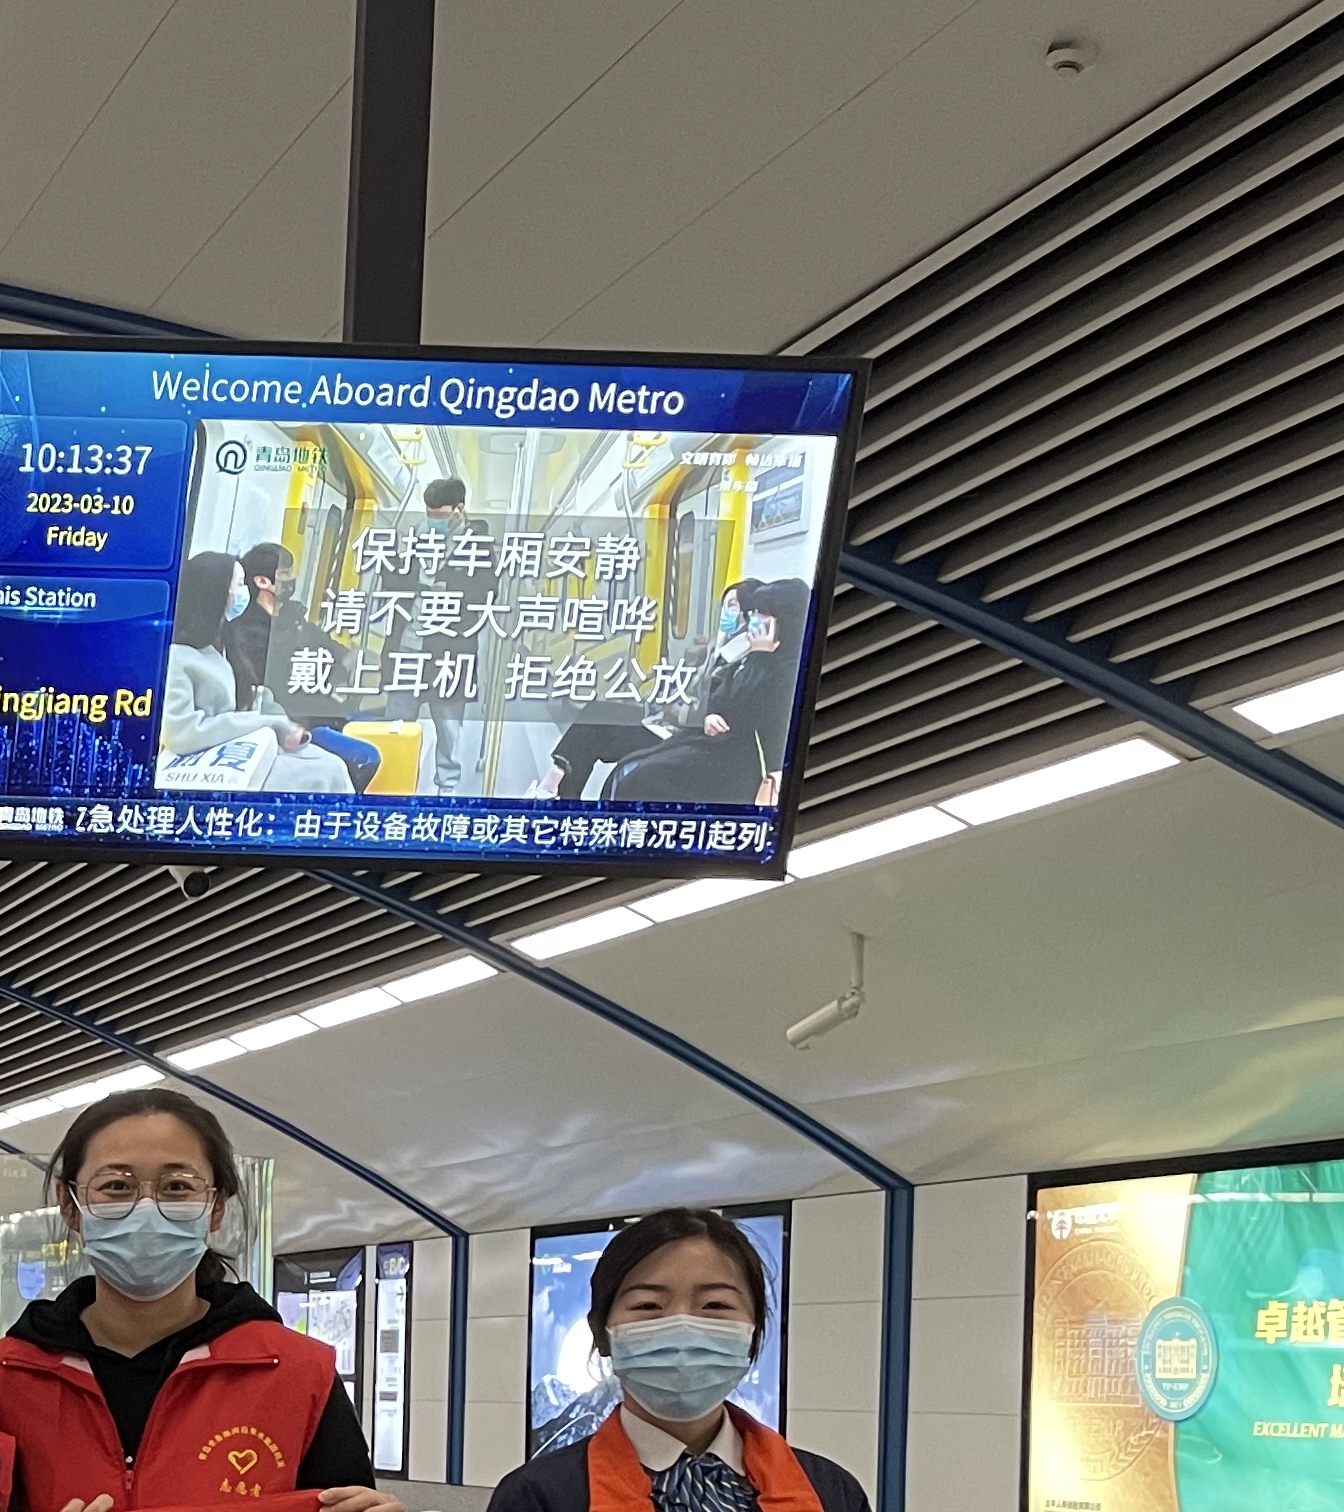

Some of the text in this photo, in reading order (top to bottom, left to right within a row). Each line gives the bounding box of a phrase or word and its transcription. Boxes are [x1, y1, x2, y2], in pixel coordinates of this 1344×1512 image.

[152, 370, 685, 419] Welcome Aboard Qingdao Metro
[19, 442, 153, 475] 10:13:37
[255, 445, 328, 465] 青岛地铁
[26, 493, 135, 515] 2023-03-10
[46, 525, 109, 552] Friday
[352, 527, 642, 582] 保持车厢安静
[25, 586, 97, 609] Station
[320, 587, 658, 643] 请不要大声喧哗
[287, 646, 699, 705] 戴上耳机 拒绝公放
[114, 688, 153, 719] Rd
[165, 772, 225, 784] SHU XIA
[1253, 1421, 1329, 1439] EXCELLENT
